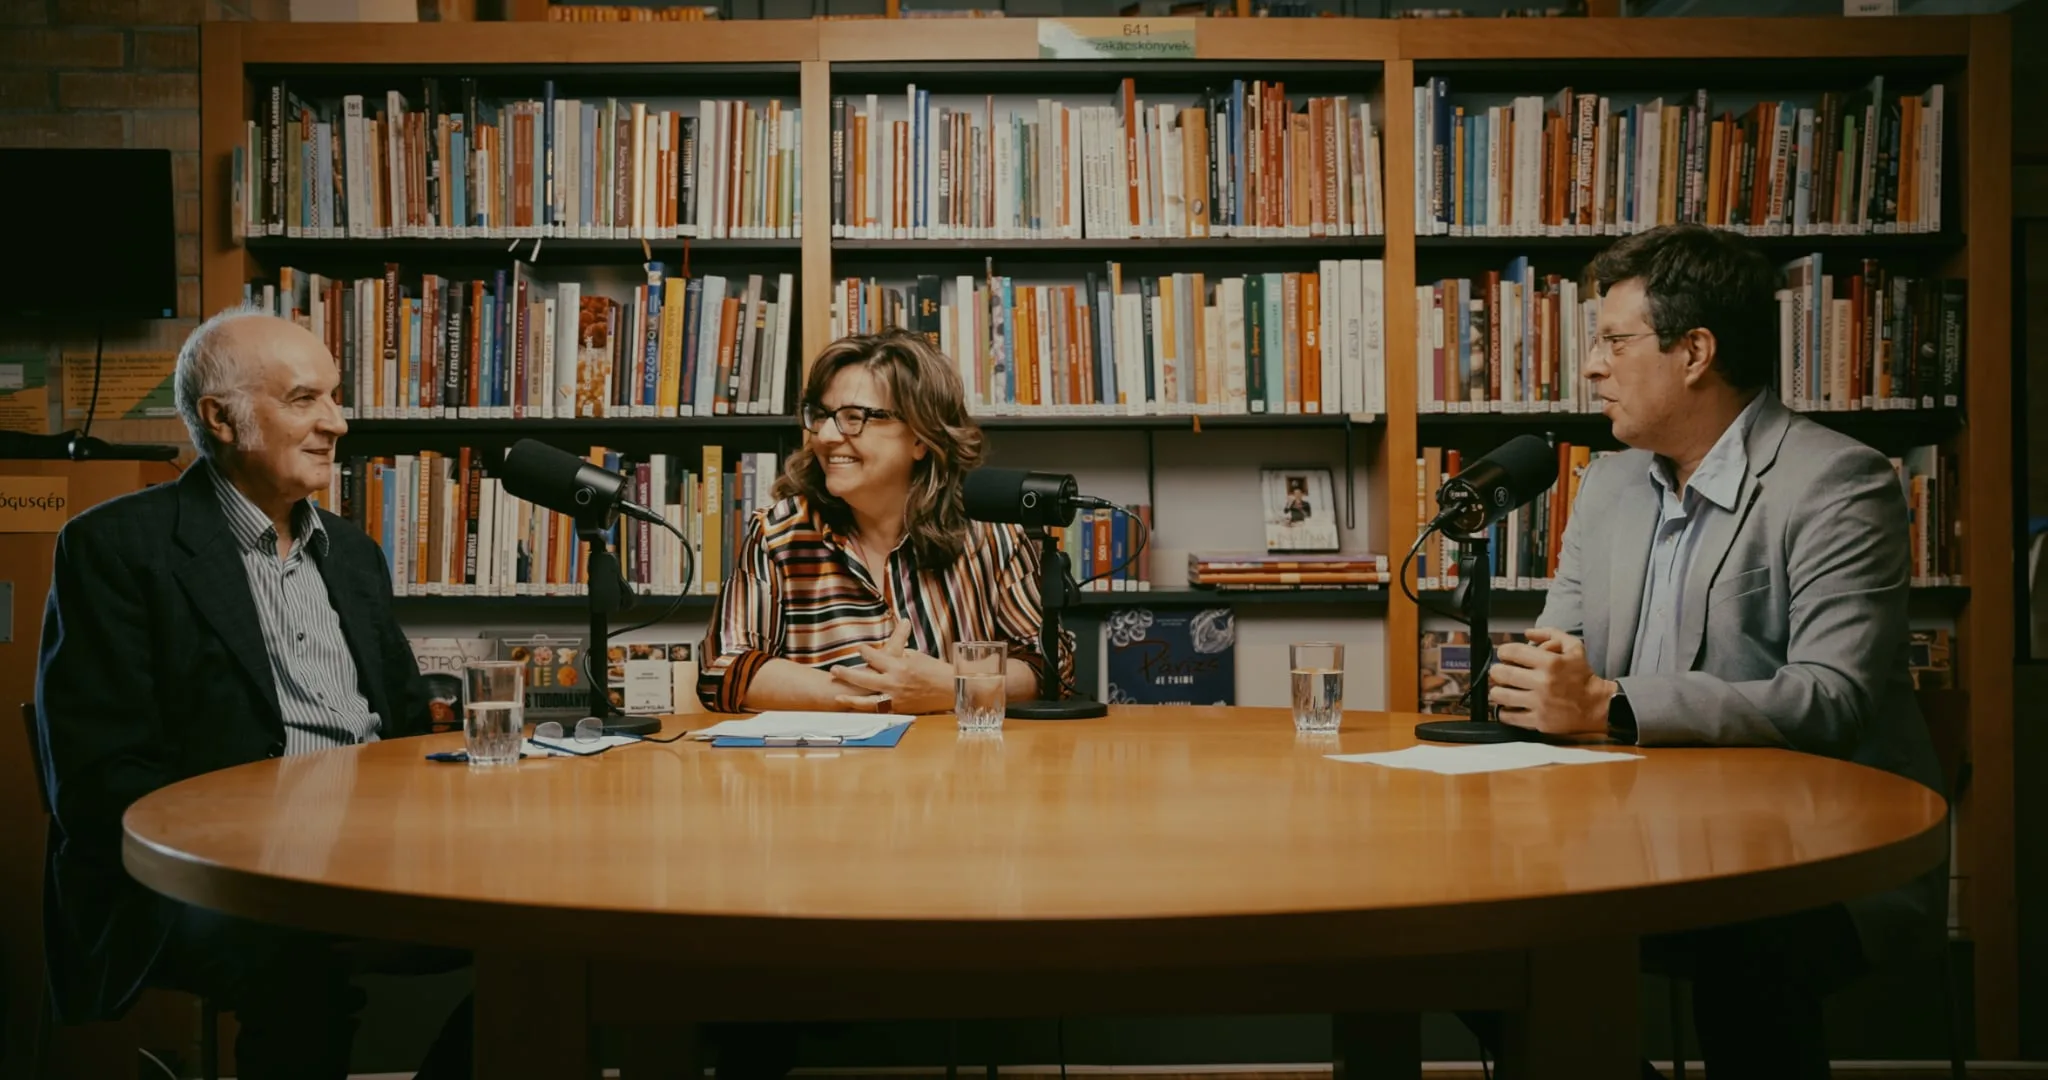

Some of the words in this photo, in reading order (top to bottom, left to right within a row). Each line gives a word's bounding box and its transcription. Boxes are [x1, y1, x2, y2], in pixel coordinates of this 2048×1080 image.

[1094, 40, 1191, 53] zakácskönyvek
[1123, 24, 1150, 37] 641
[1582, 97, 1596, 138] Gordon
[1325, 126, 1336, 173] LAWSON
[1778, 130, 1789, 157] ETETNI
[1580, 141, 1594, 187] Ramsay
[1326, 175, 1337, 219] NIGELLA
[386, 271, 396, 300] csodák
[385, 300, 396, 347] Csokoládés
[1944, 309, 1957, 347] ISTVÁN
[446, 312, 461, 388] fermentálás
[644, 316, 657, 388] FŐZŐISKOLA
[1942, 347, 1955, 386] VÁNCSA
[467, 533, 477, 557] GRYLLS
[467, 557, 476, 576] BEAR
